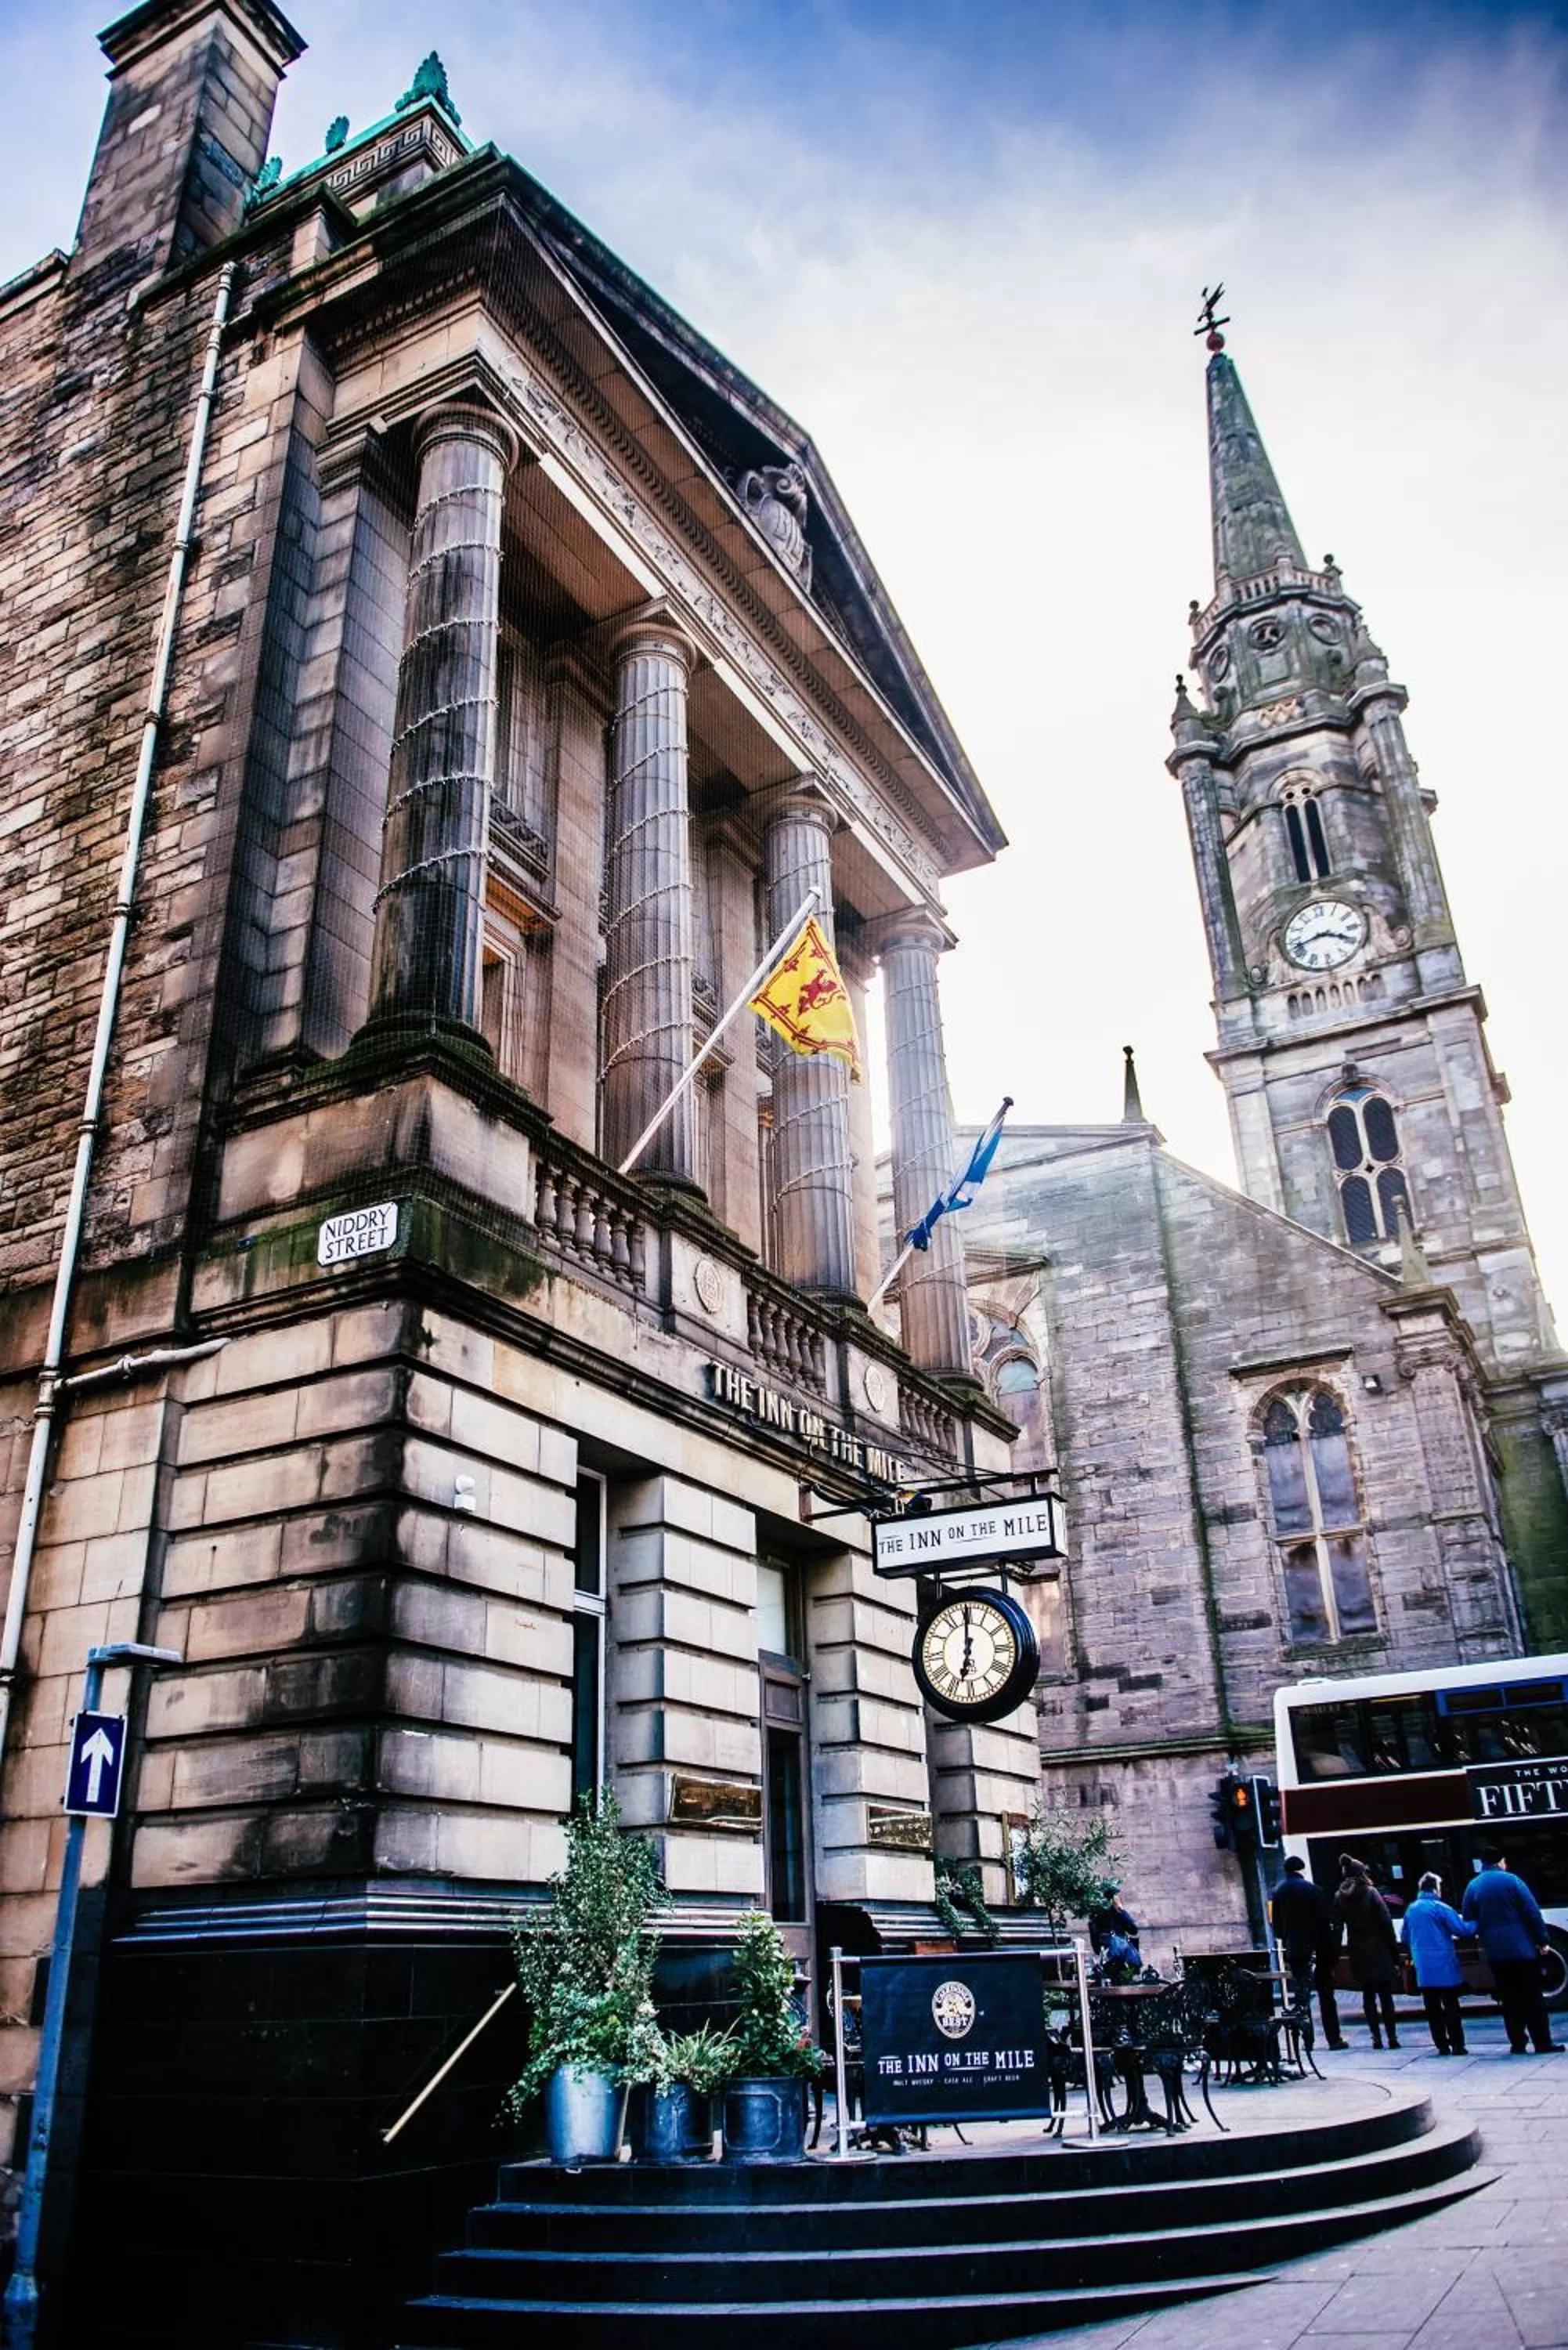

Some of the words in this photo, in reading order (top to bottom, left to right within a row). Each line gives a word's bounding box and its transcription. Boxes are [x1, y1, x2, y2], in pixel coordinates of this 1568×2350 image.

[325, 1206, 392, 1240] NIDDRY
[325, 1226, 388, 1259] STREET
[711, 1361, 757, 1412] THE
[758, 1386, 794, 1432] INN
[799, 1409, 825, 1451] ON
[829, 1425, 865, 1469] THE
[879, 1539, 903, 1554] THE
[909, 1528, 941, 1550] INN
[948, 1525, 965, 1539] ON
[970, 1520, 997, 1536] THE
[1003, 1514, 1047, 1536] MILE
[1515, 1768, 1541, 1777] THE
[1476, 1779, 1568, 1817] FIFT
[878, 2060, 902, 2074] THE
[908, 2053, 939, 2073] INN
[944, 2052, 960, 2066] ON
[964, 2052, 989, 2066] THE
[995, 2050, 1035, 2070] MILE
